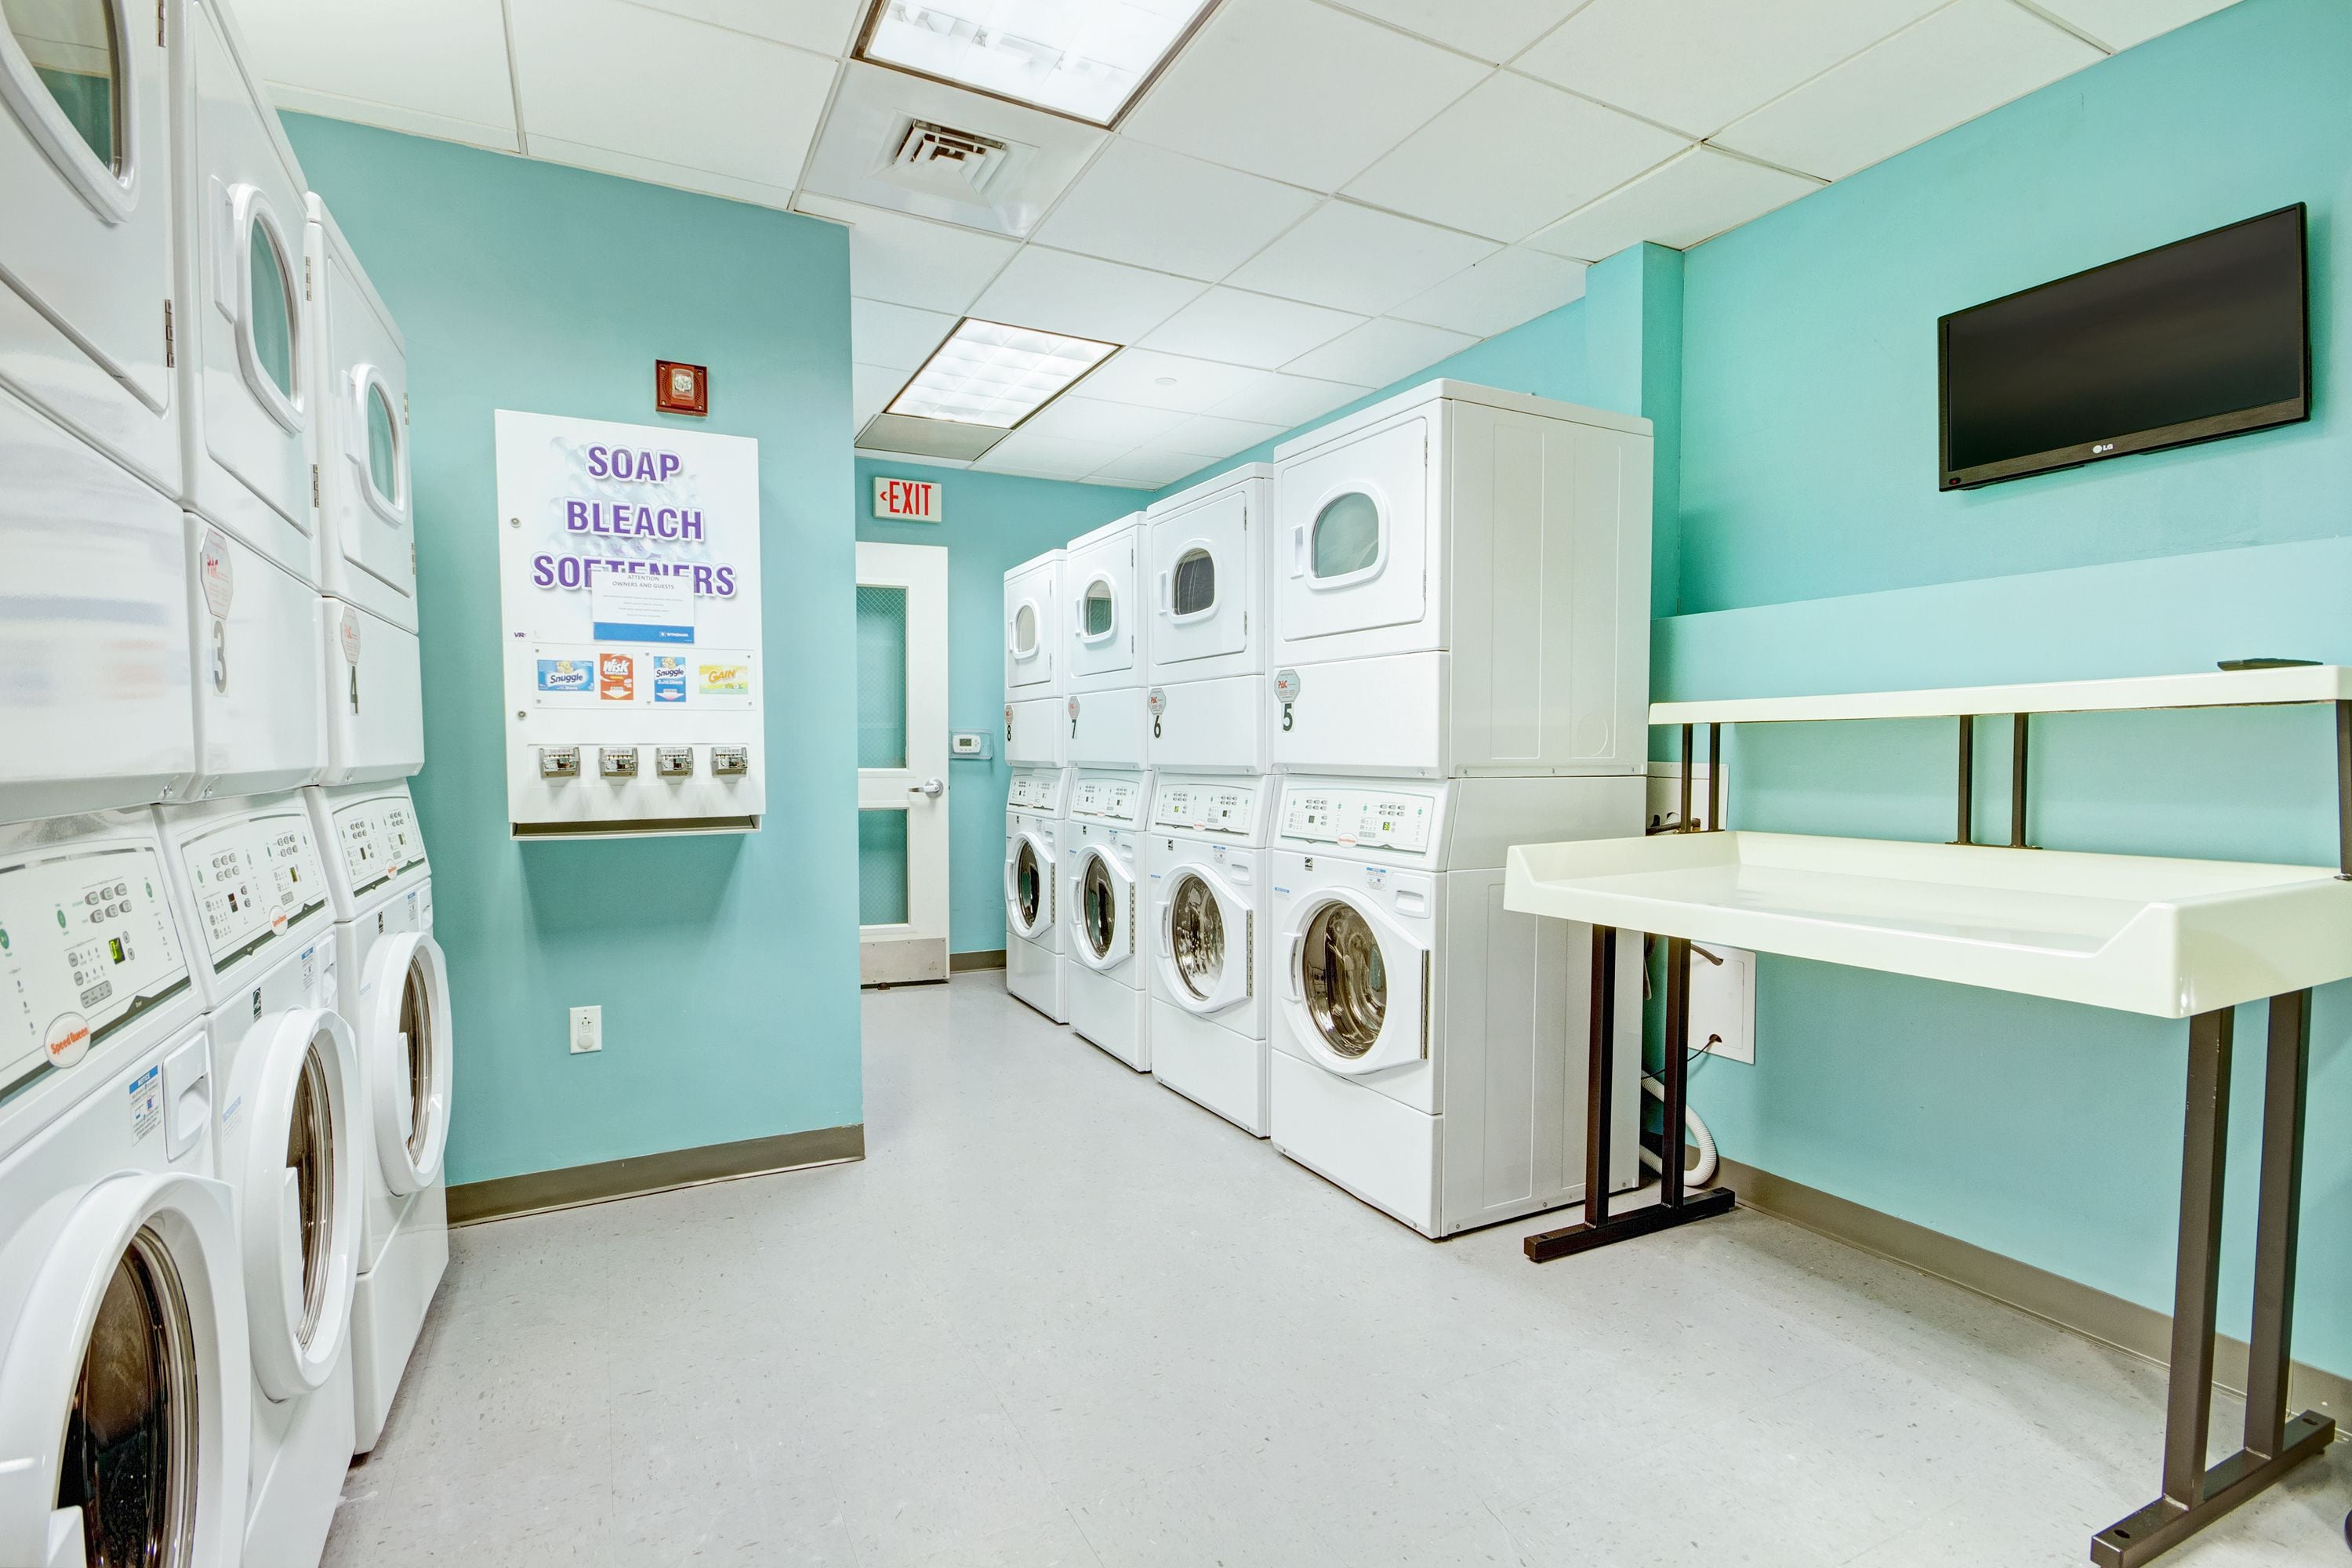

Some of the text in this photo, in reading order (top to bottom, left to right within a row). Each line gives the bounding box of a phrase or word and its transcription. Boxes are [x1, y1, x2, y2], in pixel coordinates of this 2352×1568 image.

[587, 446, 681, 482] SOAP
[889, 481, 932, 516] EXIT
[566, 500, 702, 540] BLEACH
[213, 620, 227, 694] 3
[550, 673, 583, 684] Snuggle
[656, 668, 684, 677] Snuggle
[708, 669, 736, 683] GAIN
[350, 666, 358, 714] 4
[1072, 719, 1076, 739] 7
[1154, 715, 1161, 739] 6
[1283, 703, 1294, 731] 5
[1007, 725, 1011, 741] 8
[50, 1027, 89, 1055] Speed Queen
